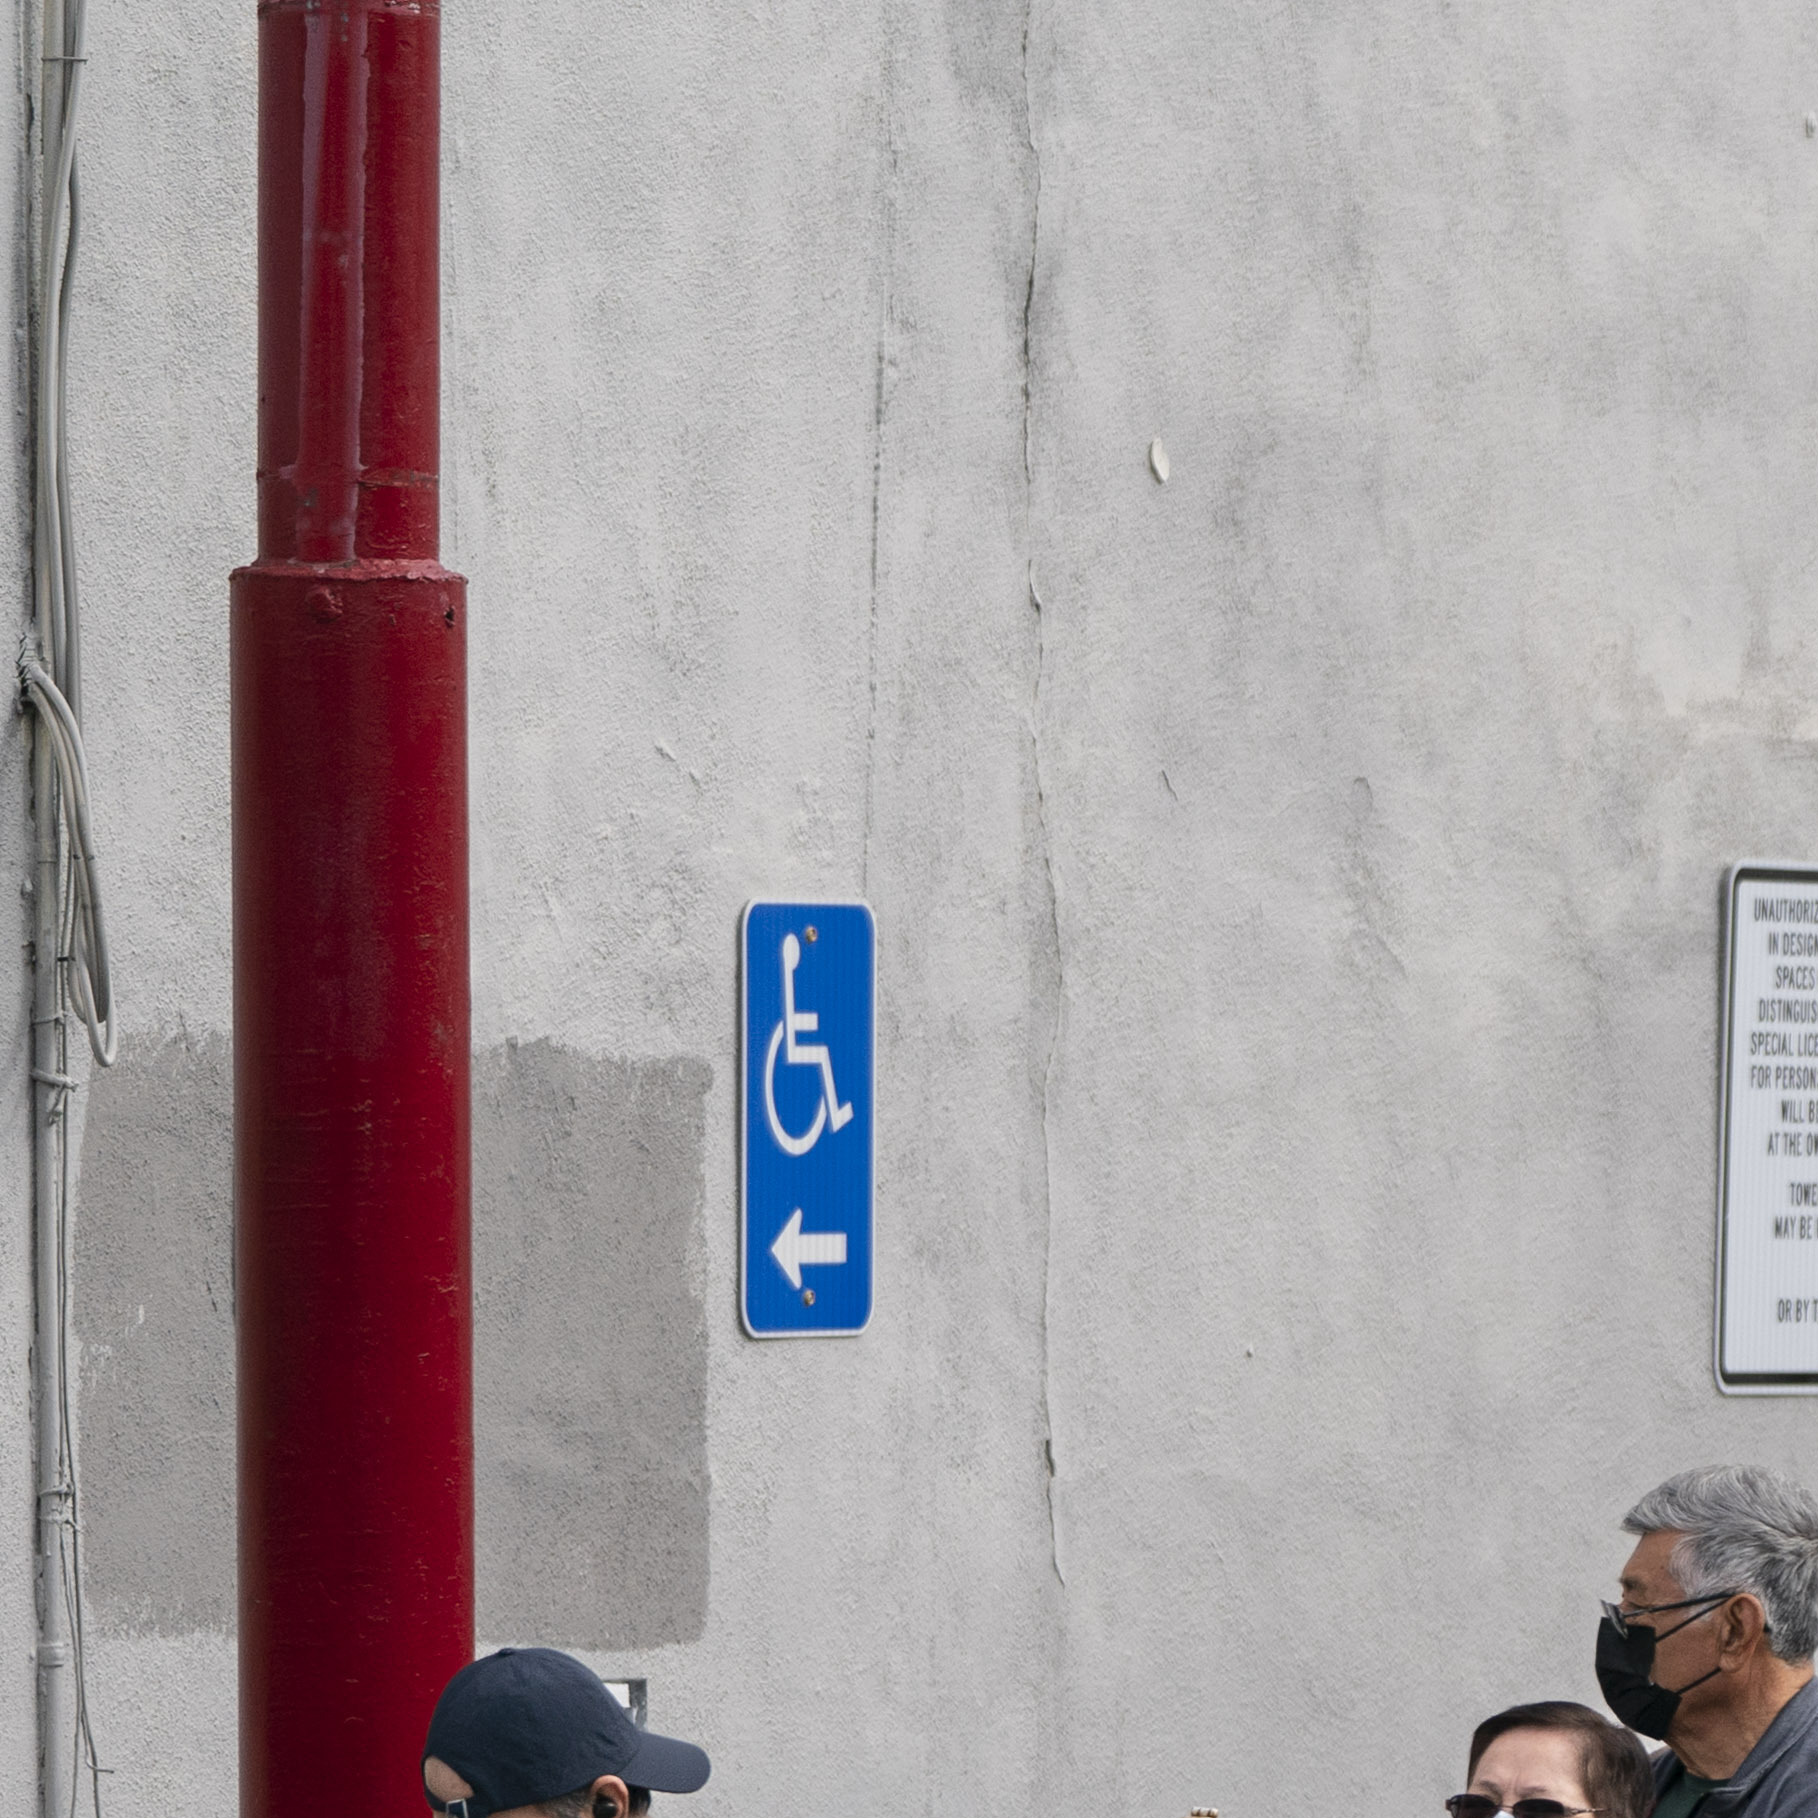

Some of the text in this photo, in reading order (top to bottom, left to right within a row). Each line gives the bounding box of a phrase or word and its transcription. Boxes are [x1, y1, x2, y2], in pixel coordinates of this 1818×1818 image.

[1769, 933, 1779, 956] IN
[1776, 967, 1816, 990] SPACES
[1750, 1033, 1793, 1056] SPECIAL
[1751, 1067, 1771, 1089] FOR
[1782, 1101, 1805, 1123] WILL
[1768, 1134, 1779, 1156] AT
[1783, 1134, 1802, 1156] THE
[1775, 1216, 1796, 1239] MAY
[1800, 1217, 1812, 1239] BE
[1778, 1299, 1792, 1322] OR
[1796, 1300, 1808, 1323] BY
